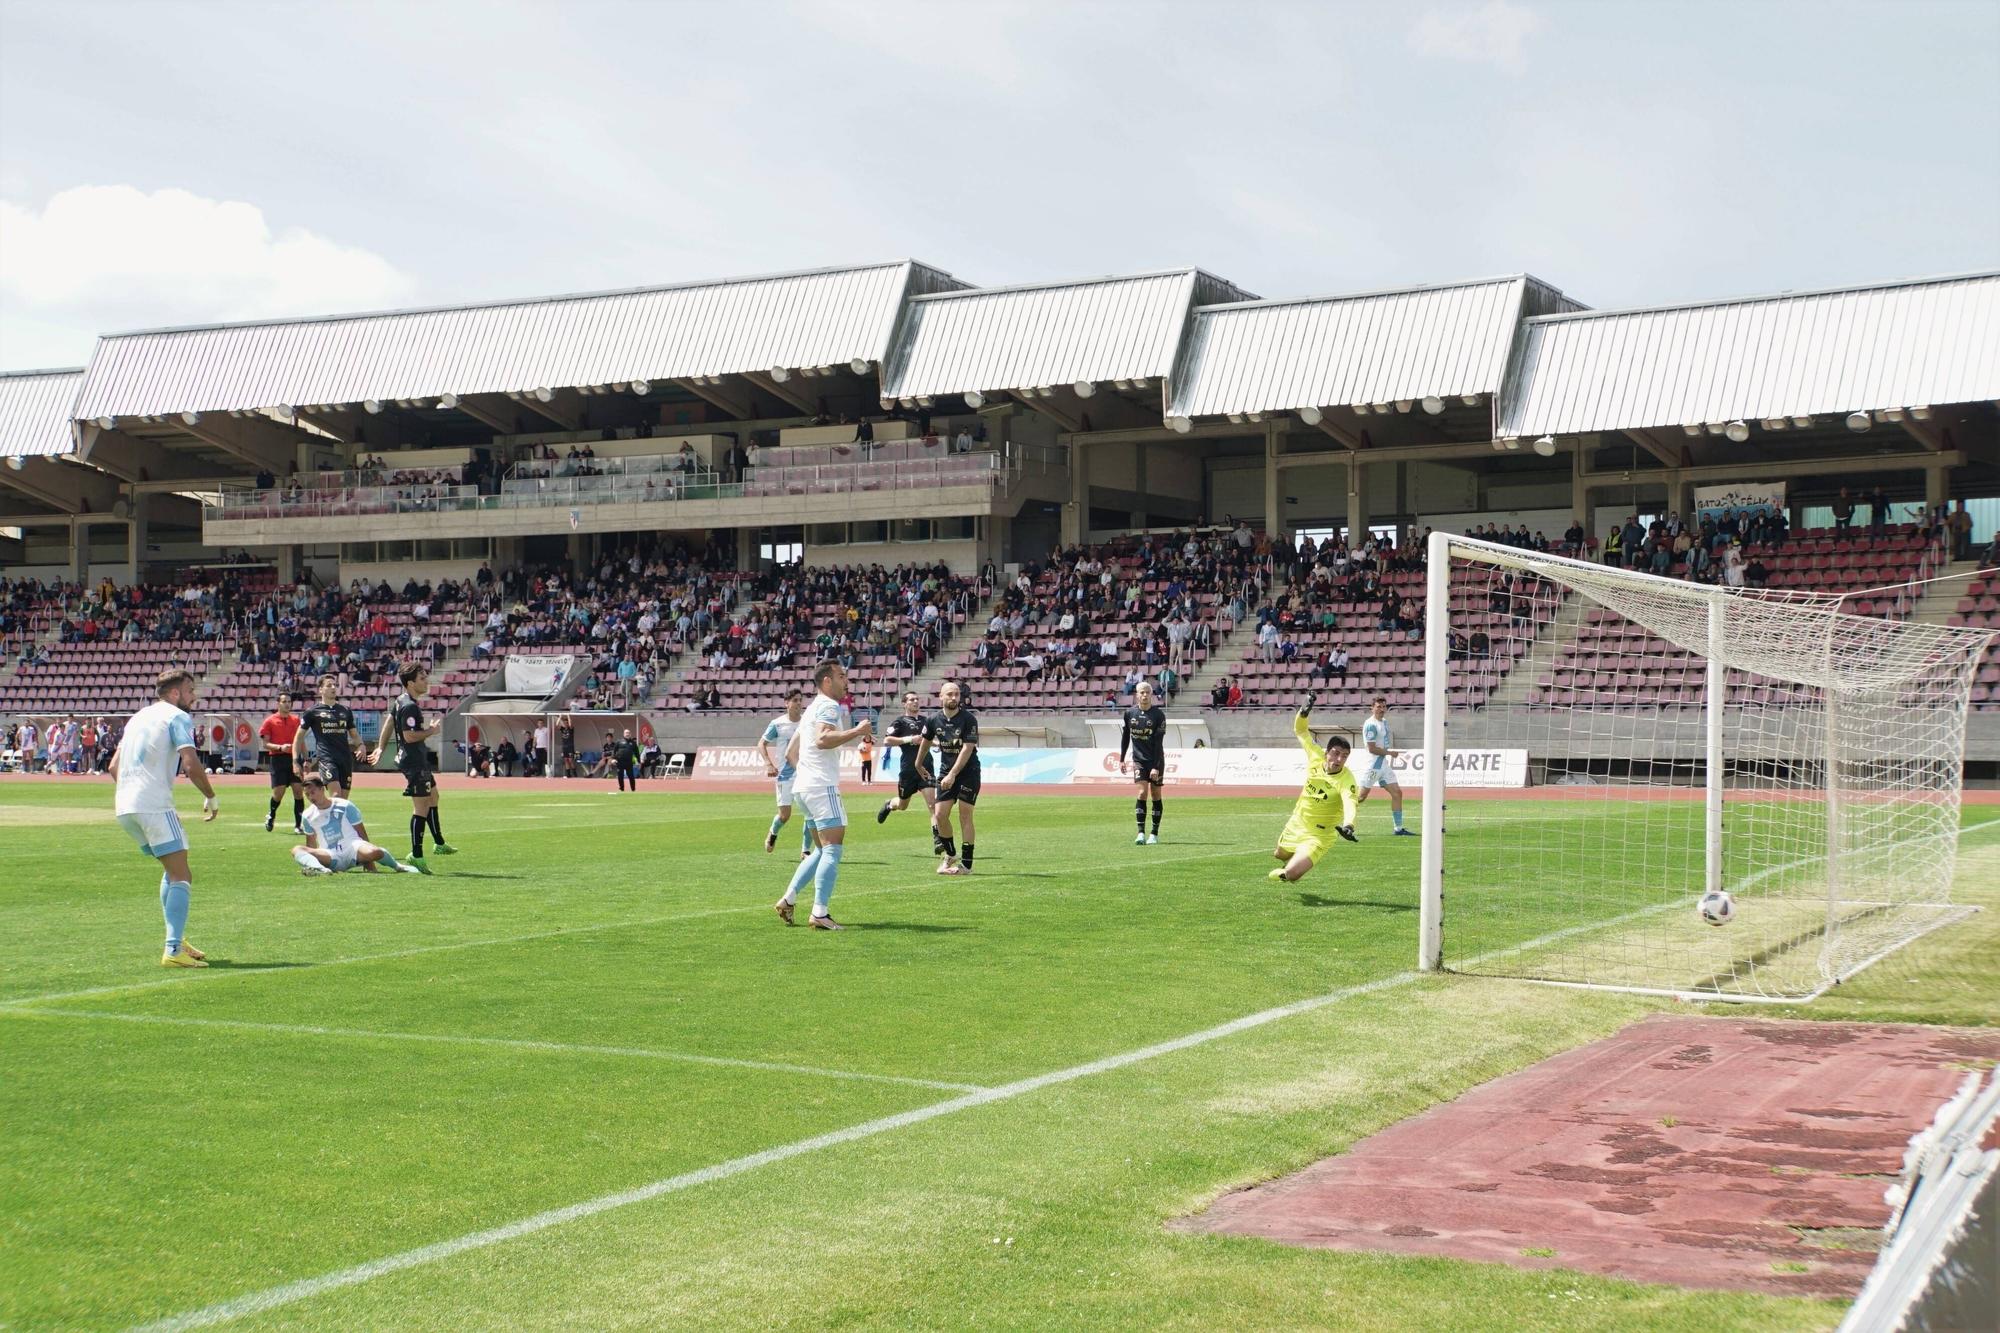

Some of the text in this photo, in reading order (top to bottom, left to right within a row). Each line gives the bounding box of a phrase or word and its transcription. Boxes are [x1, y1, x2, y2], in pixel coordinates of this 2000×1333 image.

[699, 749, 766, 767] 24 HORAS
[325, 769, 333, 778] 6
[1135, 768, 1141, 778] 2
[425, 781, 432, 792] 3
